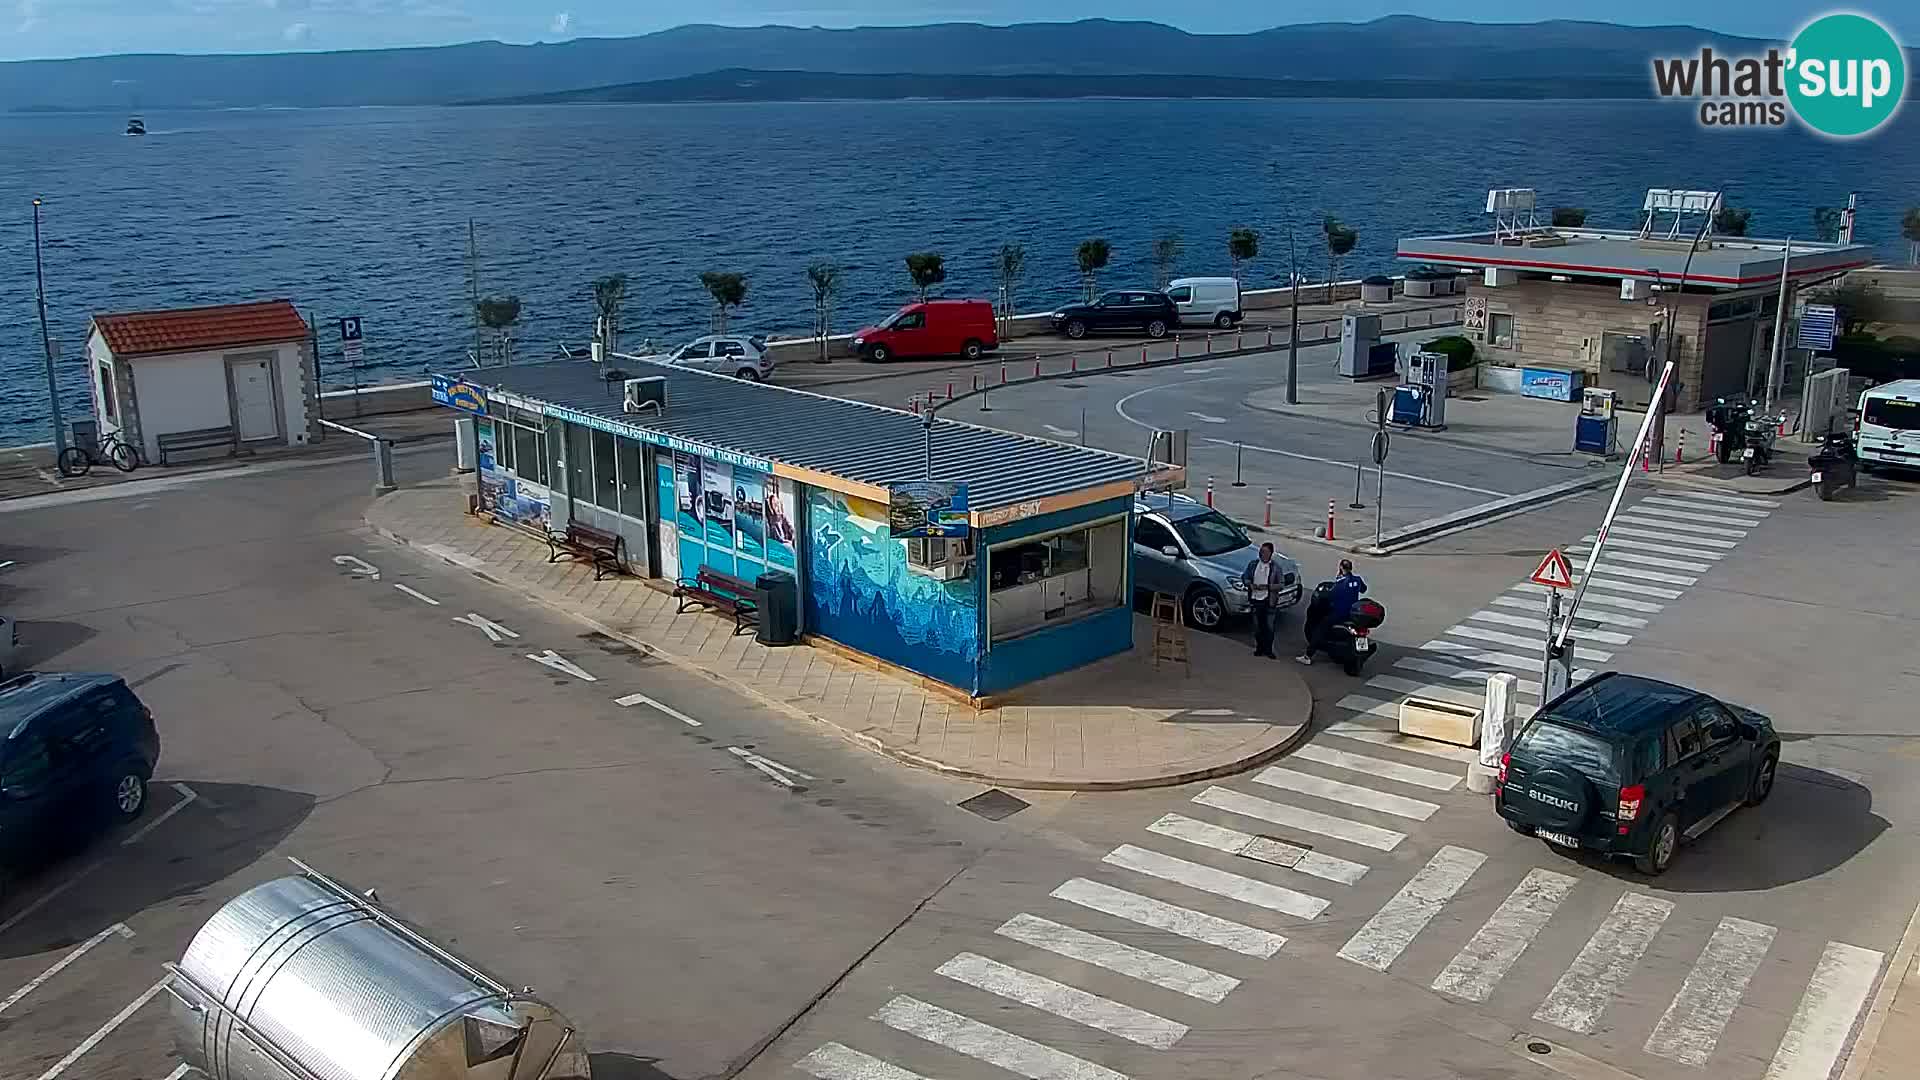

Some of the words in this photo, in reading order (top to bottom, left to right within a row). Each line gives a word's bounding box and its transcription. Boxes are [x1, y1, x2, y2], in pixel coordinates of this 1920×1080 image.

[345, 320, 356, 337] P
[669, 437, 683, 449] BUS
[684, 442, 714, 458] STATION
[716, 449, 741, 464] TICKET
[742, 456, 769, 471] OFFICE
[1528, 789, 1578, 812] SUZUKI
